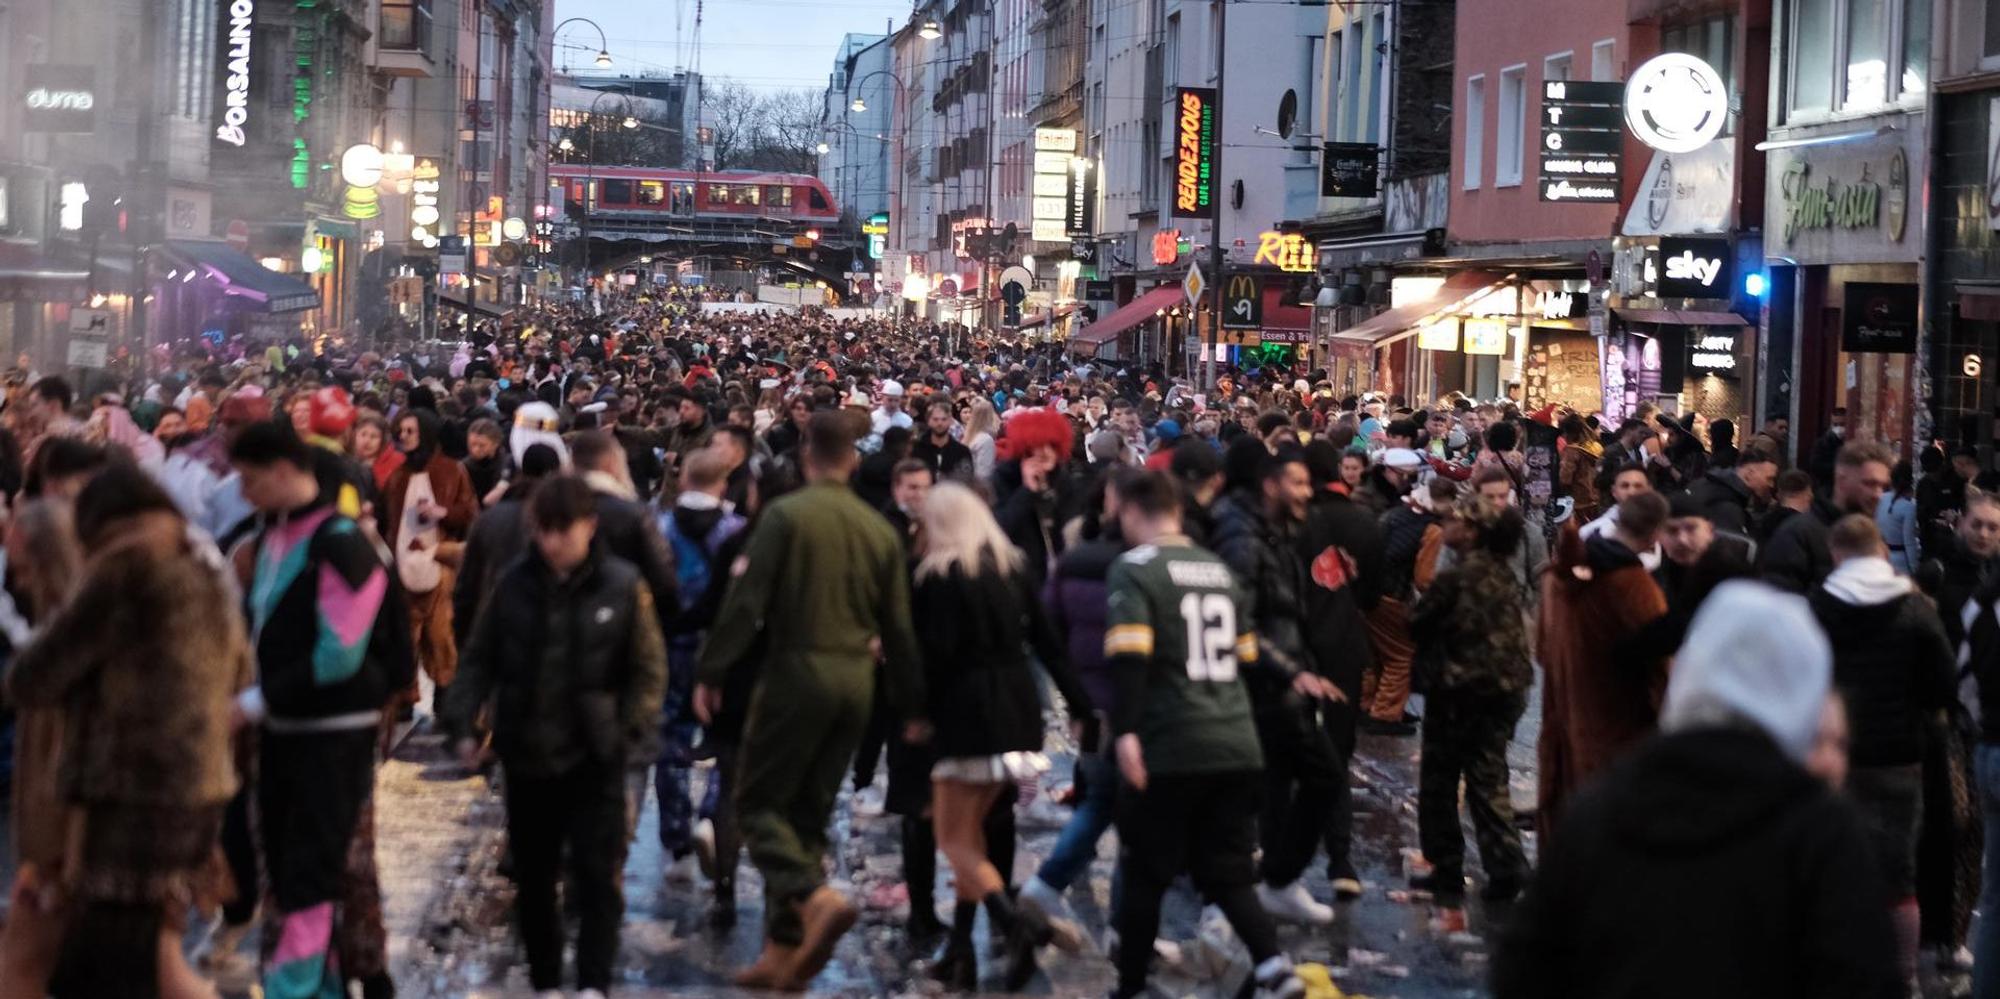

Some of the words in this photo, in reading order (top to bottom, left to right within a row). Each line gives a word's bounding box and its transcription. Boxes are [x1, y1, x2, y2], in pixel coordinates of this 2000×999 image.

[1547, 82, 1565, 99] M
[1548, 107, 1562, 124] T
[1178, 92, 1201, 211] RENDEZVOUS
[1666, 250, 1721, 286] sky
[1262, 331, 1285, 340] Essen
[1963, 354, 1981, 377] 6
[1180, 592, 1238, 682] 12
